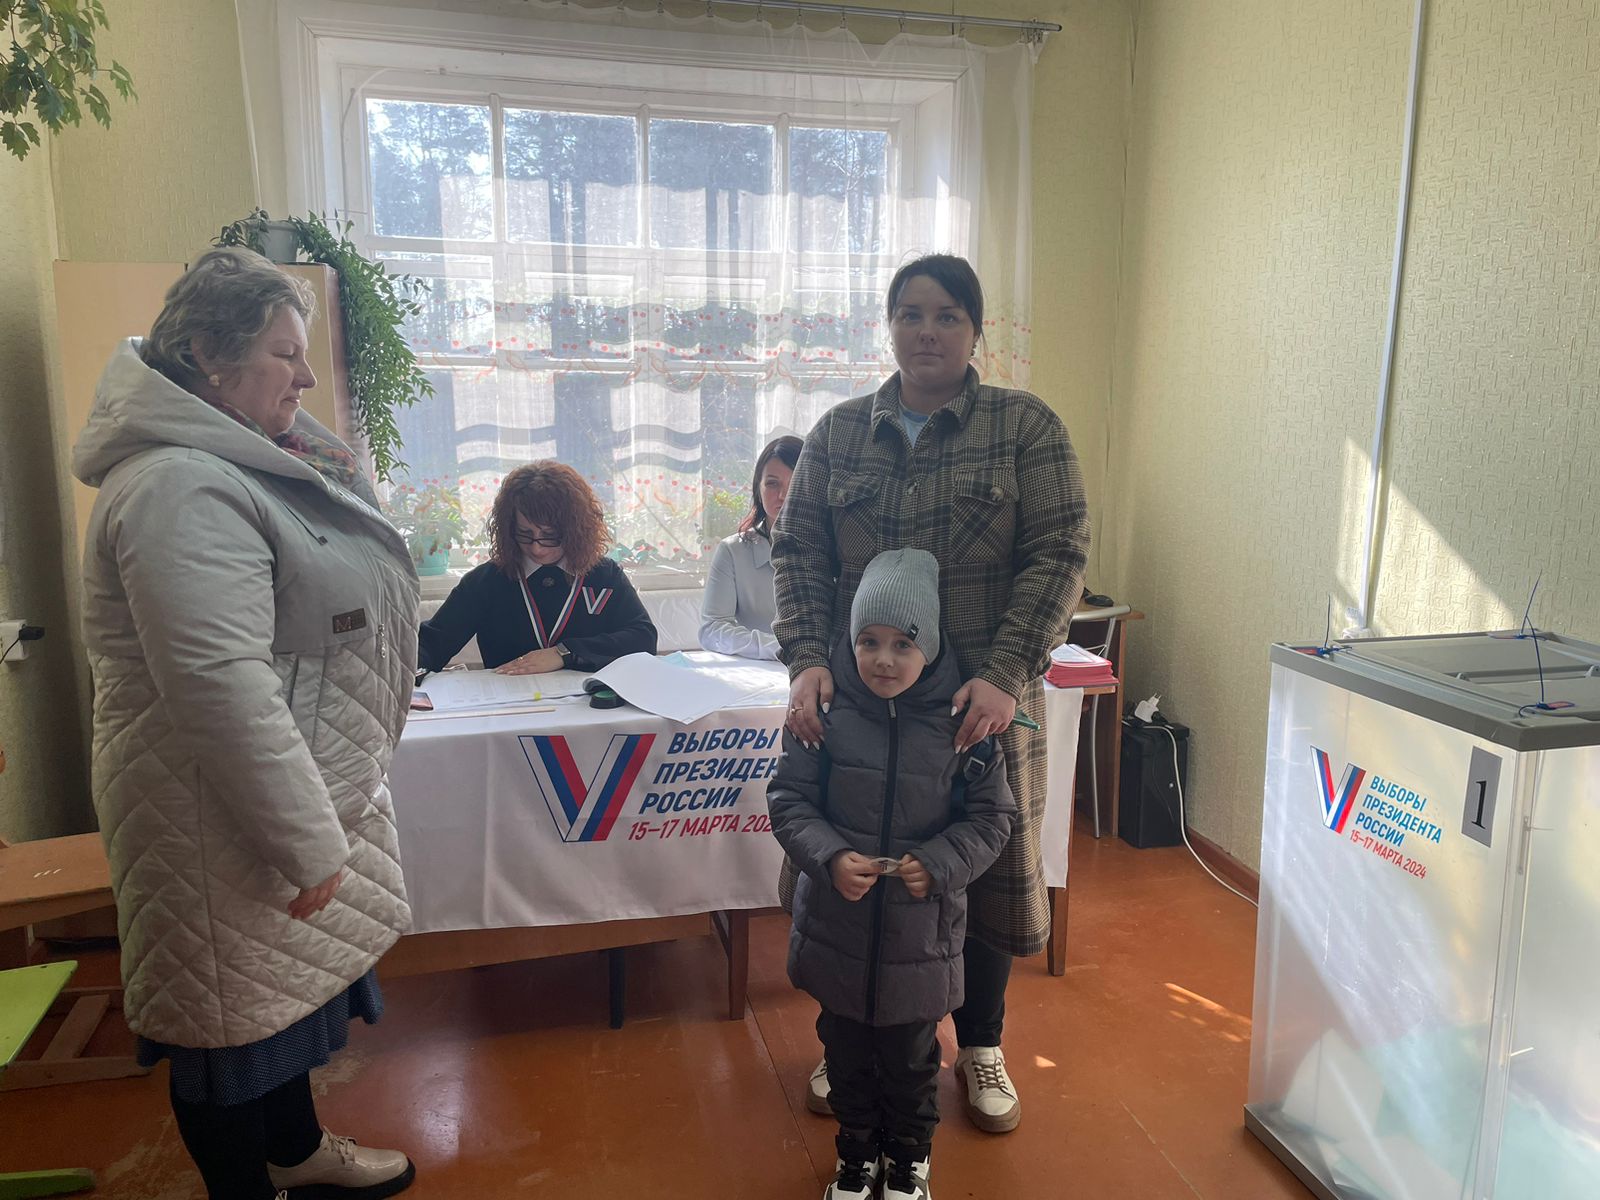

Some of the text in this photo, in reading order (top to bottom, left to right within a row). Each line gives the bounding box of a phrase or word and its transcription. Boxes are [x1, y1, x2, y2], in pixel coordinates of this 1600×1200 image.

[667, 728, 780, 754] ВЫБОРЫ
[638, 787, 742, 815] РОССИИ
[1370, 775, 1427, 812] ВЫБОРЫ
[1471, 780, 1487, 830] 1
[679, 814, 740, 838] МАРТА
[1355, 812, 1405, 848] РОССИИ
[1362, 793, 1442, 844] ПРЕЗИДЕНТА
[1372, 843, 1403, 868] МАРТА
[1402, 857, 1427, 880] 2024
